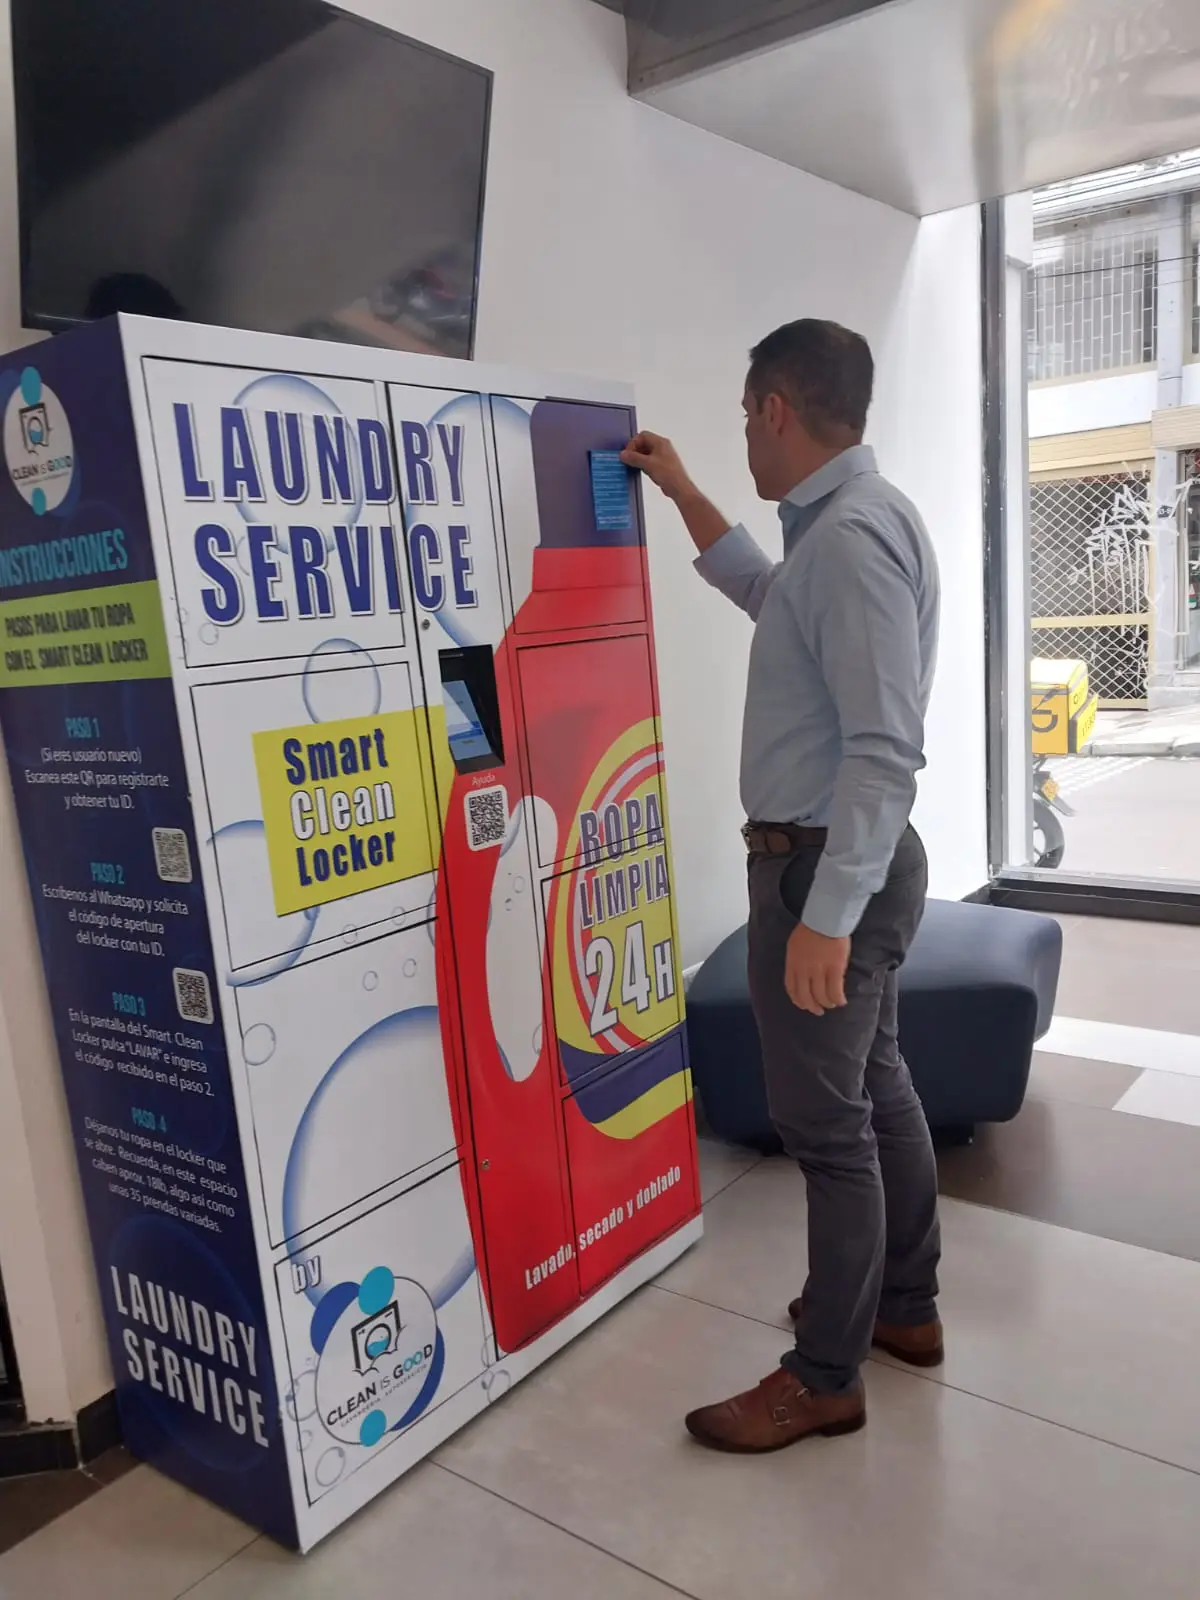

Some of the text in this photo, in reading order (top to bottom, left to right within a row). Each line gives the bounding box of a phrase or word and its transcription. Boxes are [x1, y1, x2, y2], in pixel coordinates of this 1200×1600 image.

[172, 402, 465, 505] LAUNDRY
[194, 522, 478, 626] SERVICE
[5, 602, 135, 638] PASOS PARA LAVAR TU ROPA
[5, 638, 148, 672] CON EL SMART CLEAN LOCKER
[65, 717, 100, 738] PASO 1
[52, 750, 71, 762] eres
[72, 748, 106, 763] usuario
[108, 747, 142, 764] nuevo)
[283, 728, 389, 785] Smart
[25, 769, 170, 789] Escanea este QR para registrarte
[64, 793, 135, 809] y obtener tu ID.
[472, 772, 496, 786] Ayuda
[290, 781, 396, 841] Clean
[580, 793, 664, 872] ROPA
[90, 862, 124, 884] PASO 2
[296, 831, 395, 887] Locker
[89, 889, 97, 903] al
[98, 890, 144, 912] Whatsapp
[145, 900, 152, 914] y
[153, 898, 188, 915] solicita
[579, 853, 671, 930] LIMPIA
[68, 909, 77, 922] el
[110, 913, 122, 928] de
[124, 916, 164, 934] apertura
[77, 930, 165, 957] del locker con tu ID.
[585, 920, 676, 1037] 24H
[112, 991, 146, 1017] PASO 3
[68, 1008, 203, 1051] En la pantalla del Smart Clean
[72, 1029, 100, 1047] Locker
[101, 1035, 125, 1053] pulsa
[163, 1052, 171, 1064] e
[171, 1051, 208, 1073] ingresa
[75, 1050, 83, 1062] el
[117, 1061, 154, 1080] recibido
[155, 1071, 168, 1084] en
[168, 1073, 179, 1086] el
[179, 1078, 203, 1094] paso
[131, 1106, 167, 1133] PASO 4
[84, 1137, 94, 1149] se
[118, 1146, 162, 1174] Recuerda,
[163, 1163, 175, 1177] en
[176, 1167, 196, 1184] este
[200, 1176, 238, 1198] espacio
[120, 1127, 129, 1142] tu
[130, 1134, 152, 1150] ropa
[153, 1141, 165, 1154] en
[166, 1143, 176, 1157] el
[176, 1146, 206, 1167] locker
[207, 1159, 227, 1174] que
[92, 1158, 118, 1176] caben
[170, 1184, 190, 1203] algo
[206, 1198, 235, 1218] como
[130, 1187, 142, 1203] 35
[143, 1194, 179, 1217] prendas
[180, 1209, 223, 1233] variadas.
[525, 1166, 680, 1291] Lavado, secado y doblado
[291, 1255, 321, 1294] by
[111, 1265, 257, 1377] LAUNDRY
[123, 1328, 270, 1448] SERVICE
[327, 1382, 377, 1426] CLEAN
[380, 1375, 391, 1390] IS
[393, 1344, 433, 1380] GOOD
